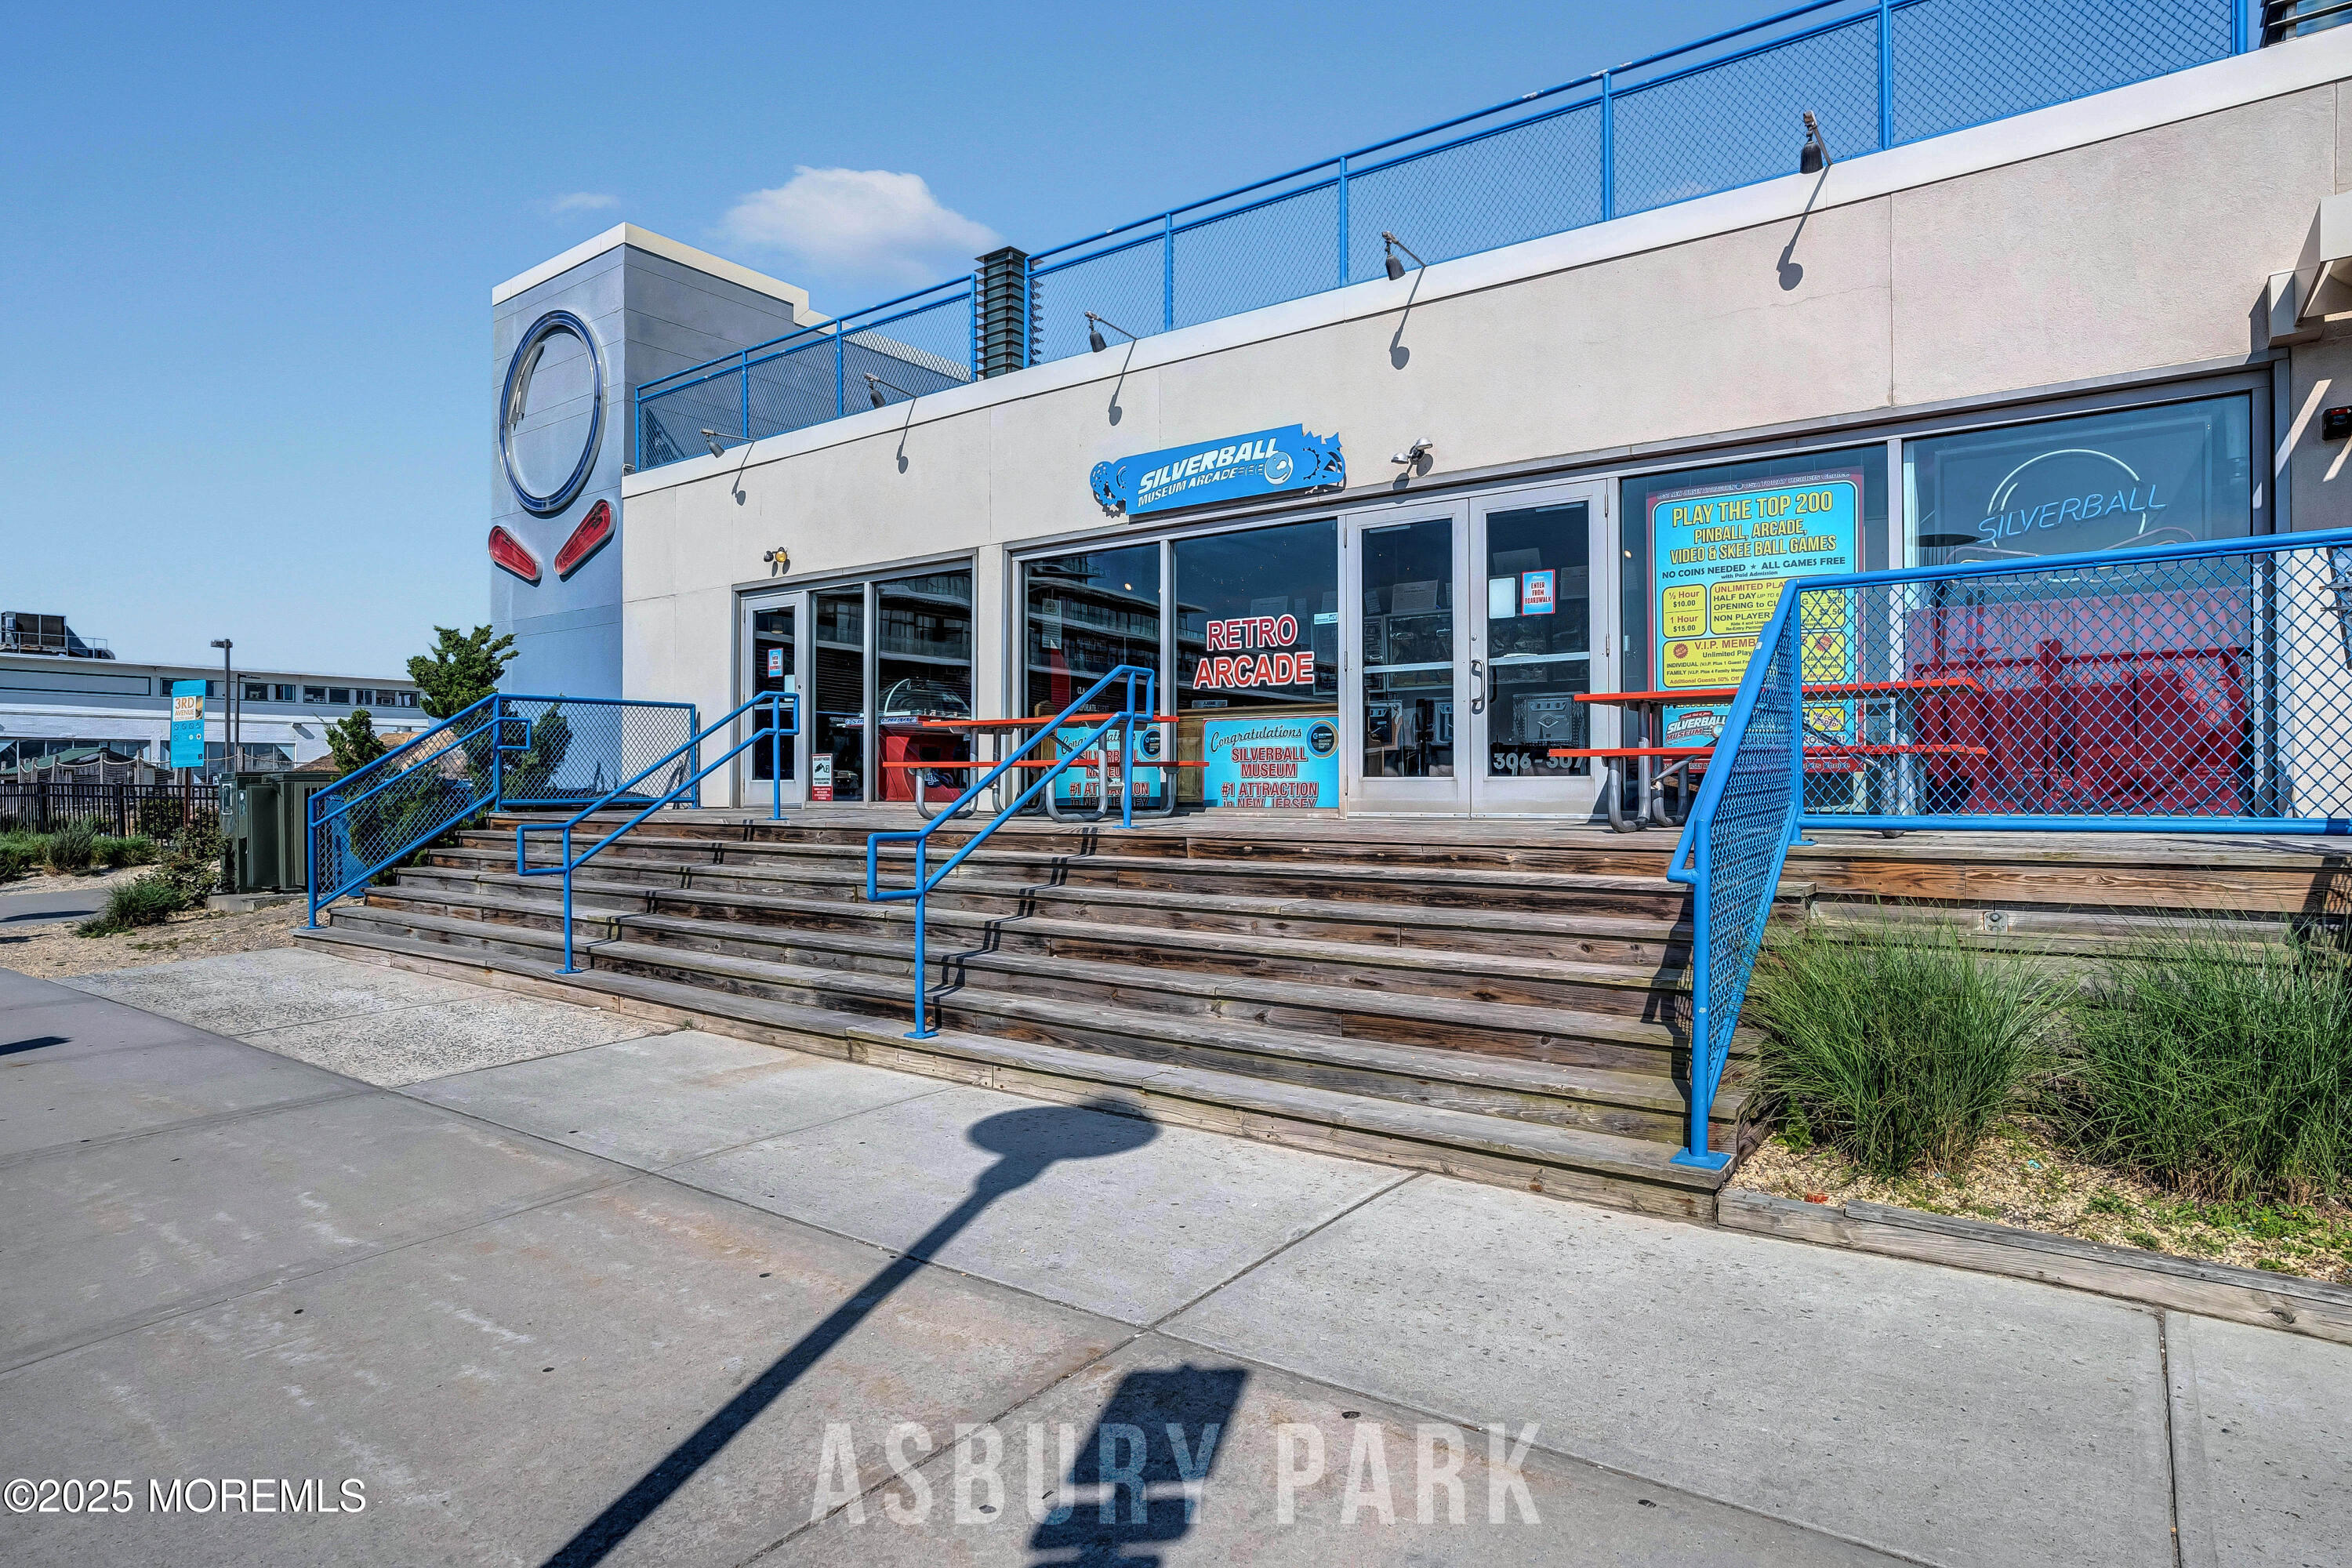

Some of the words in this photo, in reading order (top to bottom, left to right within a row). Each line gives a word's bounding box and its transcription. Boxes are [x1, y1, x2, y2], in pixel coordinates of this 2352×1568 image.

[1138, 437, 1279, 495] SILVERBALL
[1138, 479, 1187, 508] MUSEUM
[1188, 467, 1238, 488] ARCADE
[1672, 503, 1714, 528] PLAY
[1719, 499, 1751, 522] THE
[1756, 495, 1791, 517] TOP
[1795, 491, 1833, 514] 200
[1978, 484, 2167, 543] SILVERBALL
[1694, 524, 1749, 544] PINBALL,
[1751, 518, 1808, 539] ARCADE,
[1670, 546, 1705, 564] VIDEO
[1708, 546, 1717, 561] &
[1719, 542, 1751, 559] SKEE
[1755, 539, 1787, 556] BALL
[1789, 535, 1837, 554] GAMES
[1662, 571, 1675, 579] NO
[1678, 568, 1704, 578] COINS
[1708, 564, 1746, 575] NEEDED
[1761, 561, 1780, 570] ALL
[1783, 557, 1817, 568] GAMES
[1820, 557, 1846, 565] FREE
[1679, 590, 1700, 599] Hour
[1715, 583, 1763, 593] UNLIMITED
[1524, 596, 1552, 604] BOARDWALK
[1673, 600, 1696, 608] $10.00
[1713, 593, 1737, 602] HALF
[1713, 601, 1754, 611] OPENING
[1677, 615, 1698, 623] Hour
[1207, 614, 1298, 651] RETRO
[1673, 624, 1696, 633] $15.00
[1694, 641, 1718, 650] V.I.P.
[1193, 652, 1314, 689] ARCADE
[175, 697, 194, 710] 3RD
[1667, 716, 1726, 735] SILVERBALL
[1210, 724, 1301, 753] Congratulations
[1666, 728, 1703, 742] MUSEUM
[1232, 746, 1308, 762] SILVERBALL
[1241, 763, 1298, 779] MUSEUM
[1069, 782, 1081, 795] #1
[1221, 782, 1235, 797] #1
[1239, 782, 1319, 797] ATTRACTION
[1222, 798, 1233, 808] in
[1237, 798, 1265, 808] NEW
